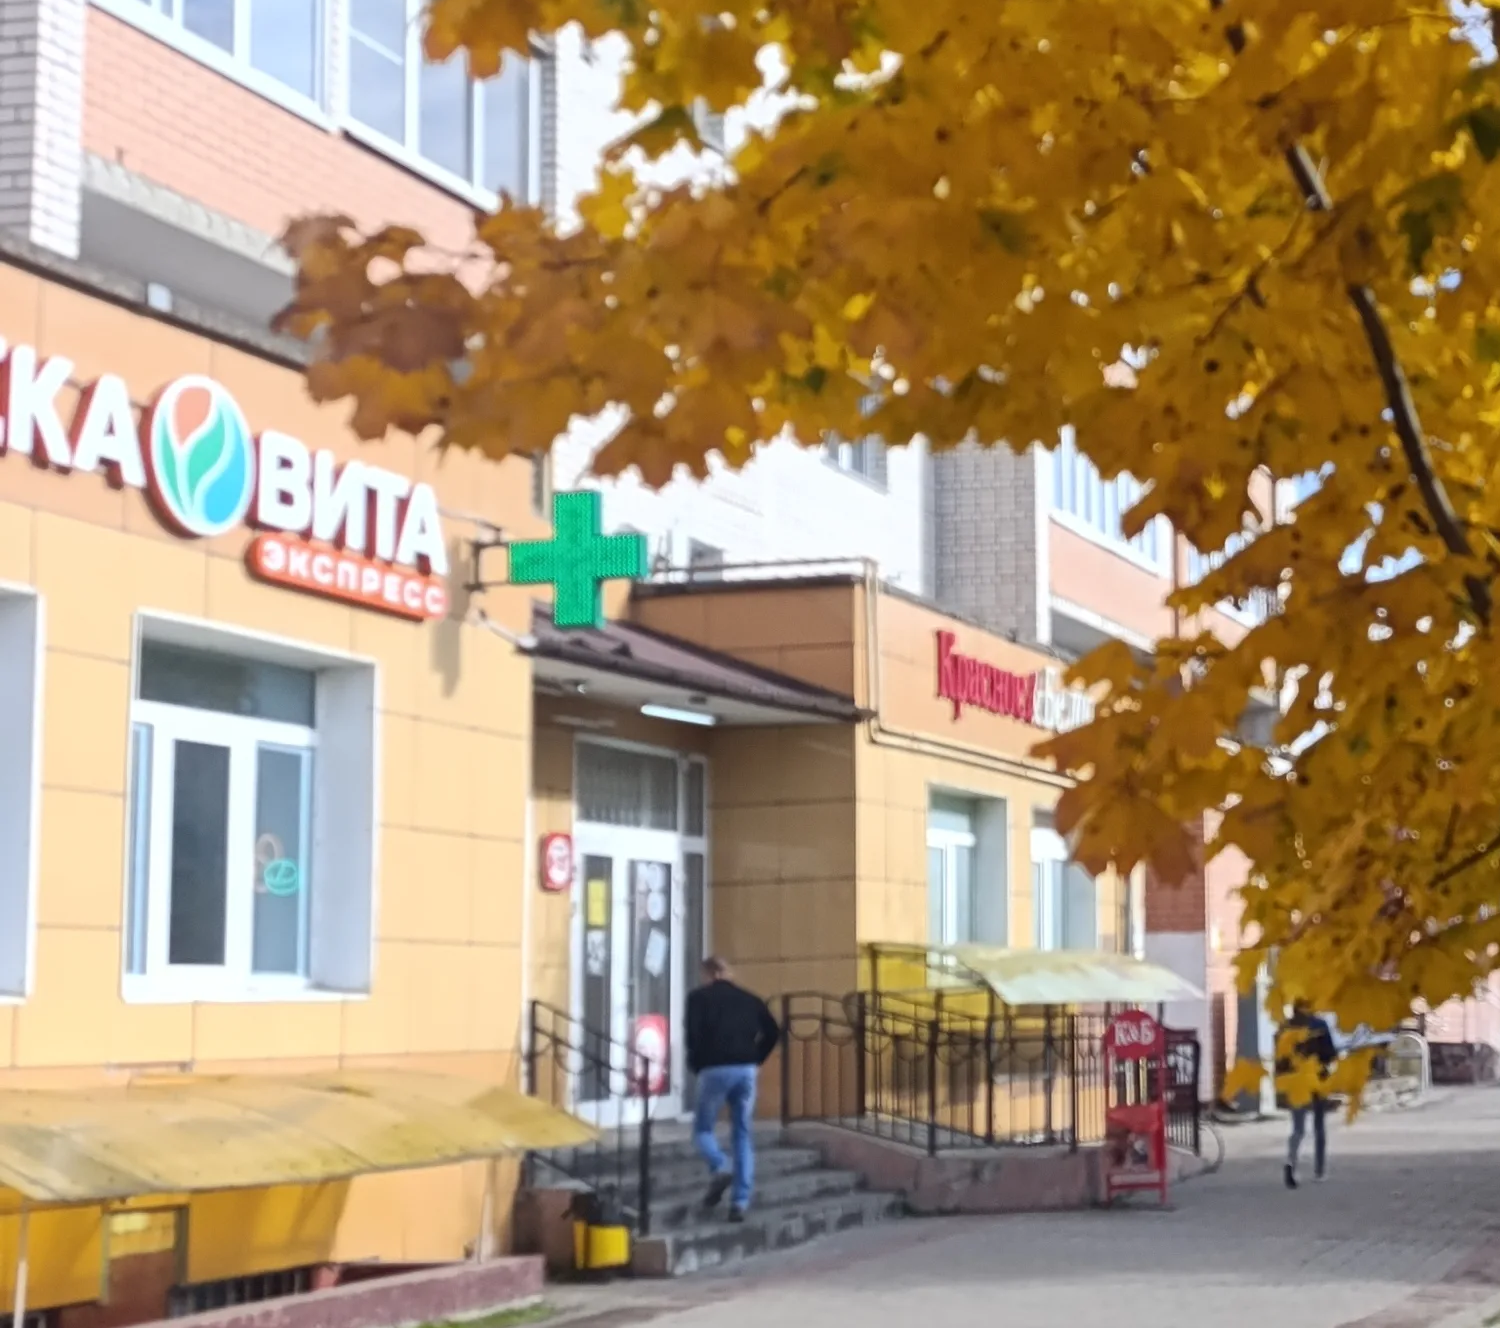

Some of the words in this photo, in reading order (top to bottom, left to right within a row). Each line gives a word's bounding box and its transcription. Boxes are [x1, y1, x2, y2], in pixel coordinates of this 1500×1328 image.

[0, 334, 148, 489] КА
[256, 429, 449, 576] ВИТА
[261, 539, 446, 615] ЭКСПРЕСС
